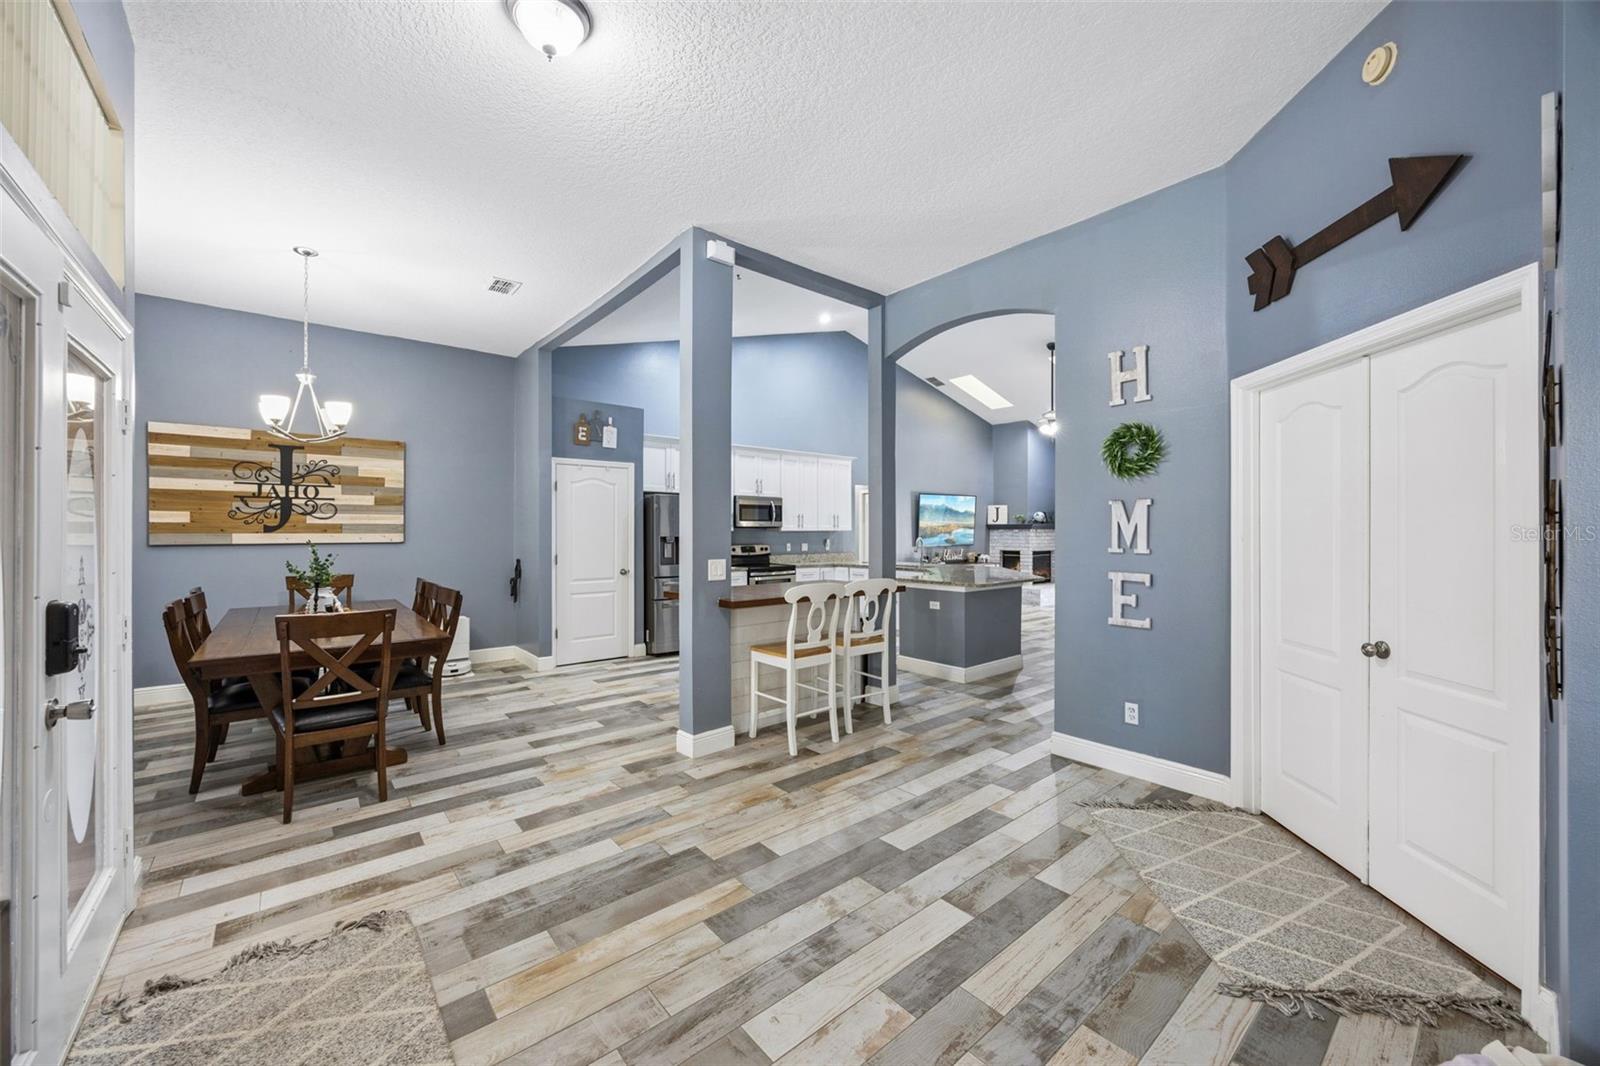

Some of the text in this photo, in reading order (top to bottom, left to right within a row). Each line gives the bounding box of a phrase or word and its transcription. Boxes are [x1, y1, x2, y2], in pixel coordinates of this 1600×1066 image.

[578, 426, 588, 441] E
[263, 443, 305, 533] J
[992, 507, 1000, 523] J
